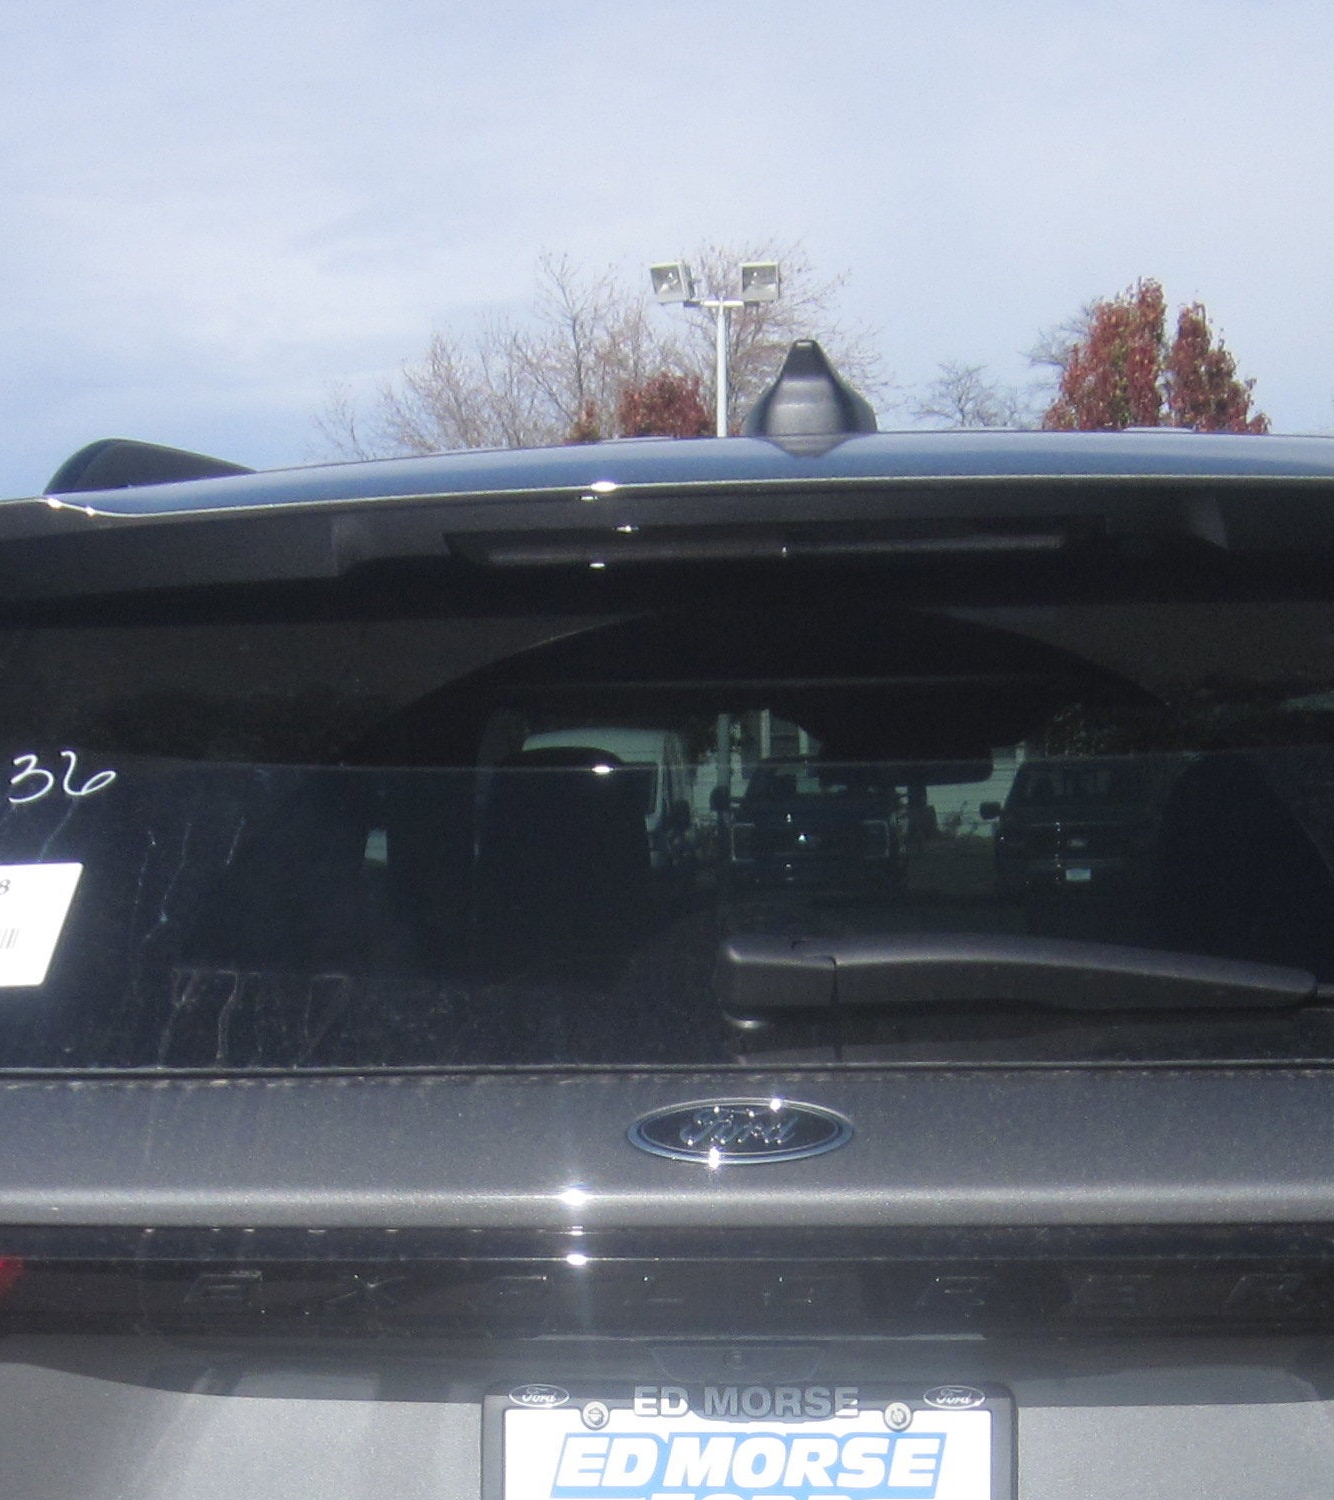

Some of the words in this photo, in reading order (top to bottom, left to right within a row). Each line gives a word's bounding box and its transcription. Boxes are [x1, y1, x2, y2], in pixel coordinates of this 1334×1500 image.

[633, 1385, 689, 1417] ED
[703, 1386, 860, 1418] MORSE
[555, 1436, 659, 1488] ED
[662, 1436, 942, 1489] MORSE
